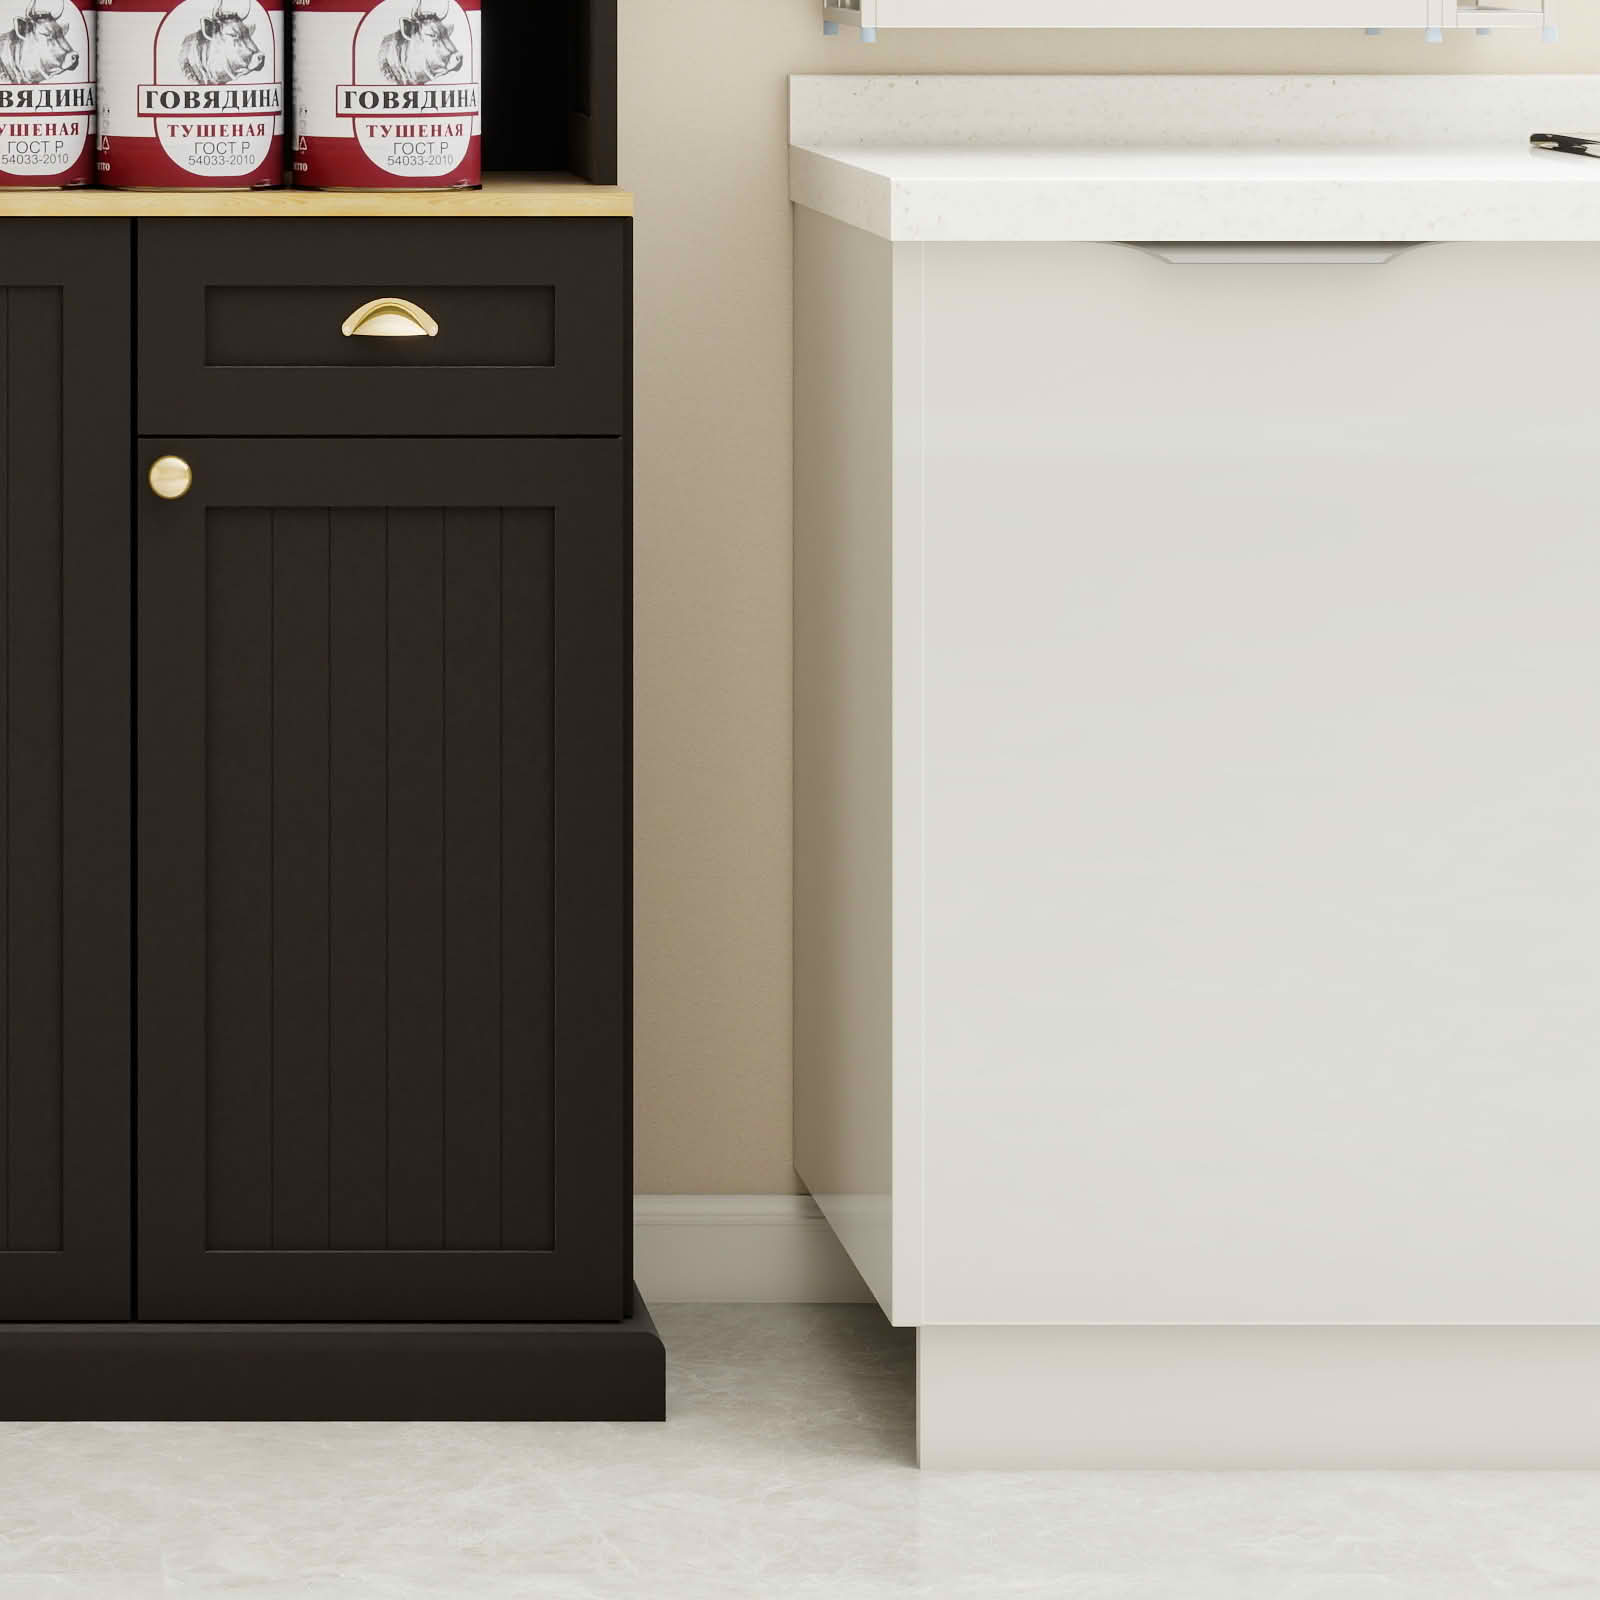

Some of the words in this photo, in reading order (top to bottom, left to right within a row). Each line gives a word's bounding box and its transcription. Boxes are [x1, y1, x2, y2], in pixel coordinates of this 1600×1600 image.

[146, 89, 281, 111] ГОВЯДИНА
[345, 90, 477, 111] ГОВЯДИНА
[167, 124, 265, 137] ТУШЕНАЯ
[366, 124, 464, 137] ТУШЕНАЯ
[7, 140, 50, 153] ГОСТ
[54, 140, 64, 153] Р
[194, 141, 236, 154] ГОСТ
[241, 141, 251, 153] Р
[393, 141, 435, 154] ГОСТ
[440, 141, 449, 154] Р
[1, 153, 69, 165] 54033-2010
[187, 154, 256, 166] 54033-2010
[386, 155, 455, 166] 54033-2010
